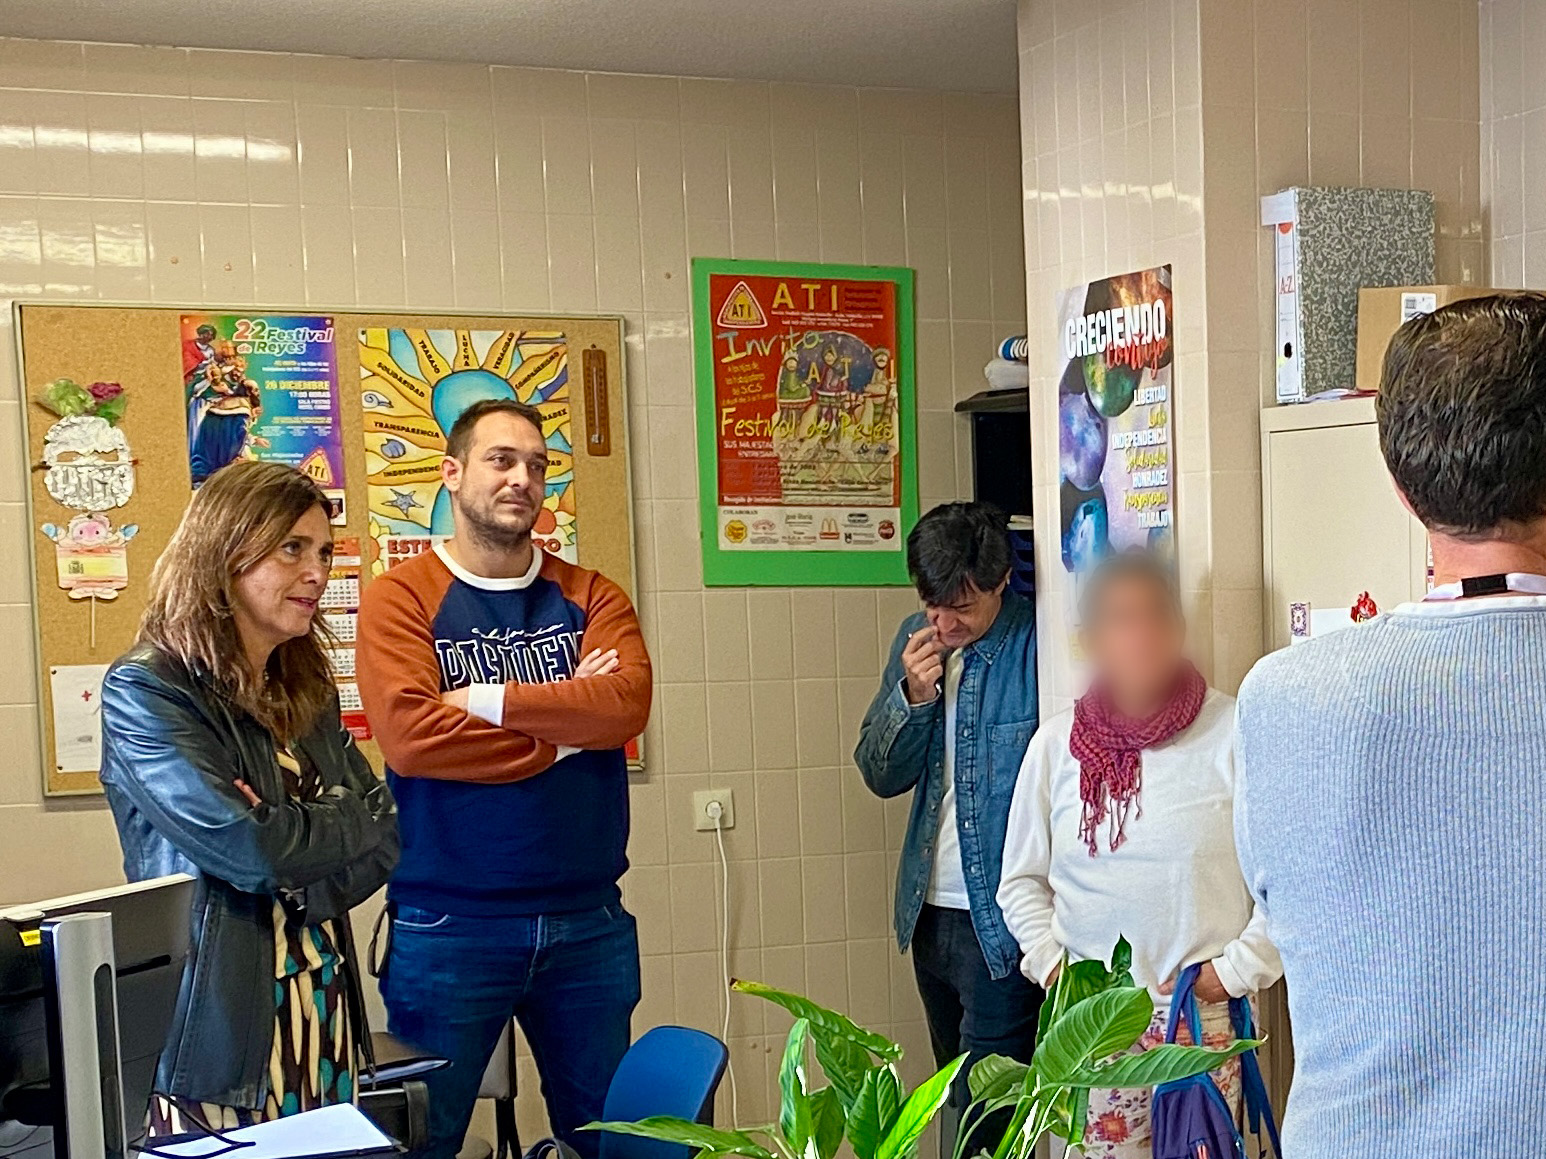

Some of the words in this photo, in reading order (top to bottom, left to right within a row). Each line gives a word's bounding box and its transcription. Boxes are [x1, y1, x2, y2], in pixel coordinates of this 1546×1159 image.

[772, 282, 838, 311] ATI
[731, 303, 752, 318] ATI
[233, 319, 267, 341] 22
[266, 327, 334, 342] Festival
[1065, 298, 1166, 360] CRECIENDO
[255, 341, 306, 357] Reyes
[418, 340, 441, 375] TRABAJO
[462, 334, 471, 367] LUCHA
[493, 332, 515, 369] VERACIDAD
[377, 361, 425, 399] SOLIDARIDAD
[1133, 384, 1167, 406] LIBERTAD
[374, 421, 440, 438] TRANSPARENCIA
[721, 407, 797, 438] Festival
[1112, 427, 1167, 450] INDEPENDENCIA
[1138, 509, 1170, 530] TRABAJO
